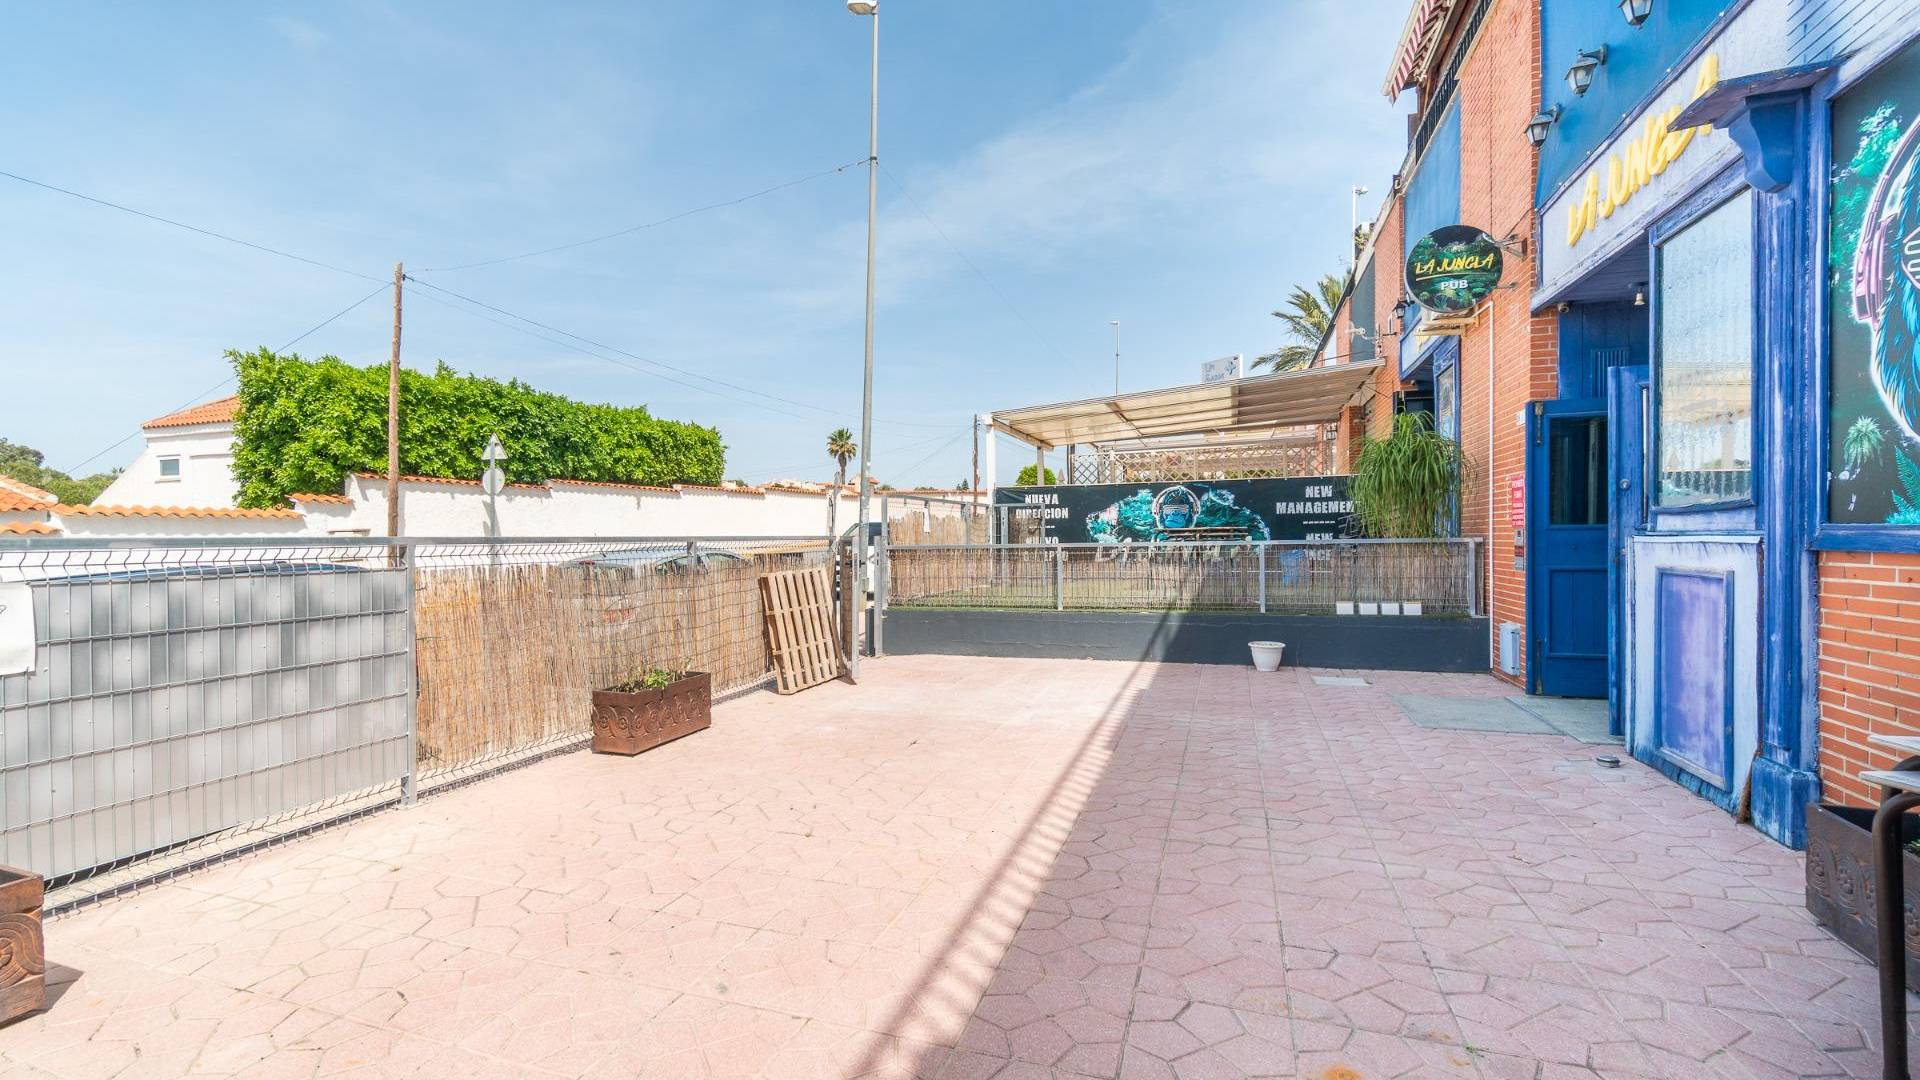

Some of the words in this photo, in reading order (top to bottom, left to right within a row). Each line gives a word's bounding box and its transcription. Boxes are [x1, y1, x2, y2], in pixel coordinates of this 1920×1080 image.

[1567, 169, 1599, 247] LA
[1414, 259, 1435, 275] LA
[1437, 253, 1495, 272] JUNGLA
[1440, 279, 1469, 291] PUB
[1305, 485, 1333, 498] NEW
[1024, 493, 1059, 505] NUEVA
[1015, 507, 1069, 519] DIRECION
[1275, 501, 1355, 515] MANAGEMEN
